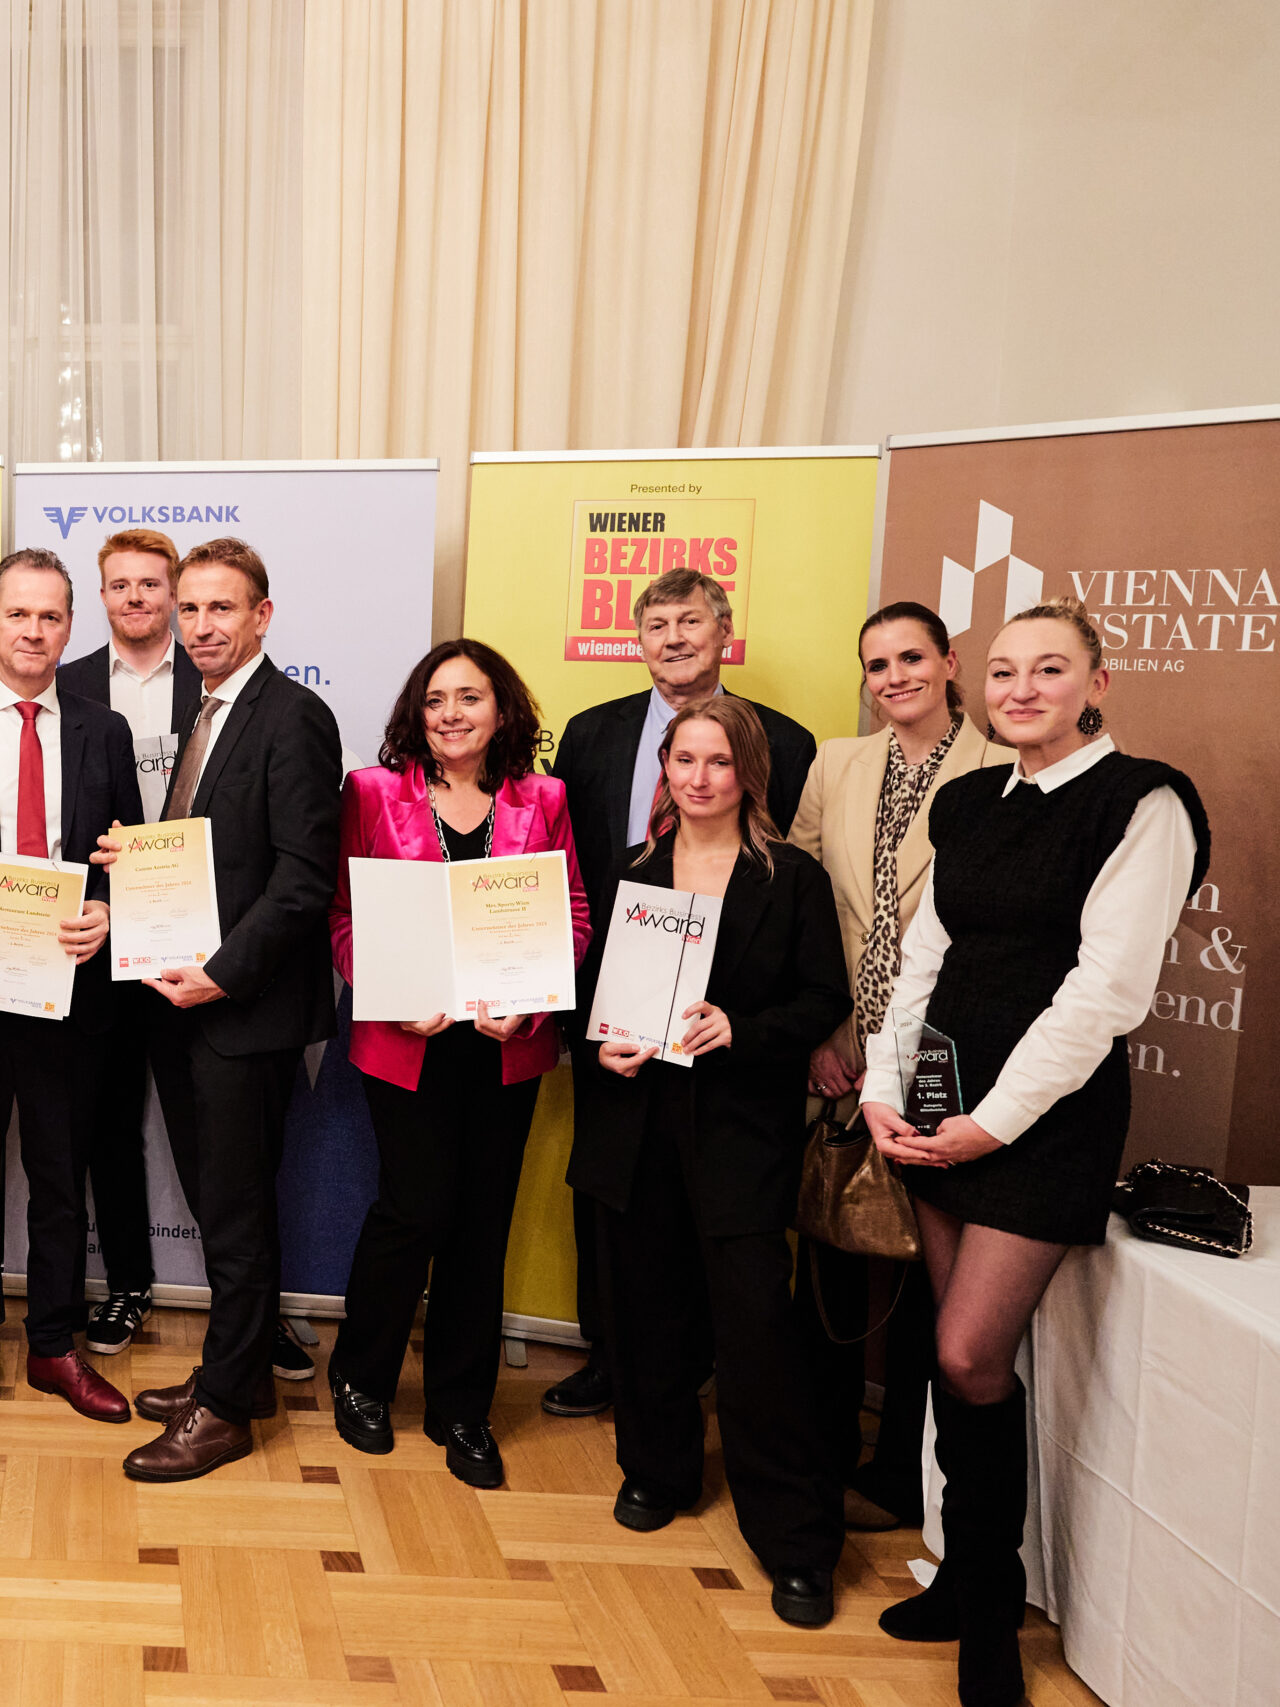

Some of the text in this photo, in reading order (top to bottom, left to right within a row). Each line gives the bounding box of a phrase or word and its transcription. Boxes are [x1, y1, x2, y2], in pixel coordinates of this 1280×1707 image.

[630, 484, 703, 495] Presented by
[92, 506, 240, 523] VOLKSBANK
[588, 512, 666, 532] WIENER
[583, 537, 738, 575] BEZIRKS
[1067, 568, 1280, 607] VIENNA
[1087, 613, 1277, 651] STATE
[1162, 660, 1185, 672] AG
[128, 832, 184, 853] Award
[472, 871, 539, 892] Award
[626, 902, 706, 938] Award
[641, 903, 703, 920] Bezirks Business
[1199, 926, 1248, 974] &
